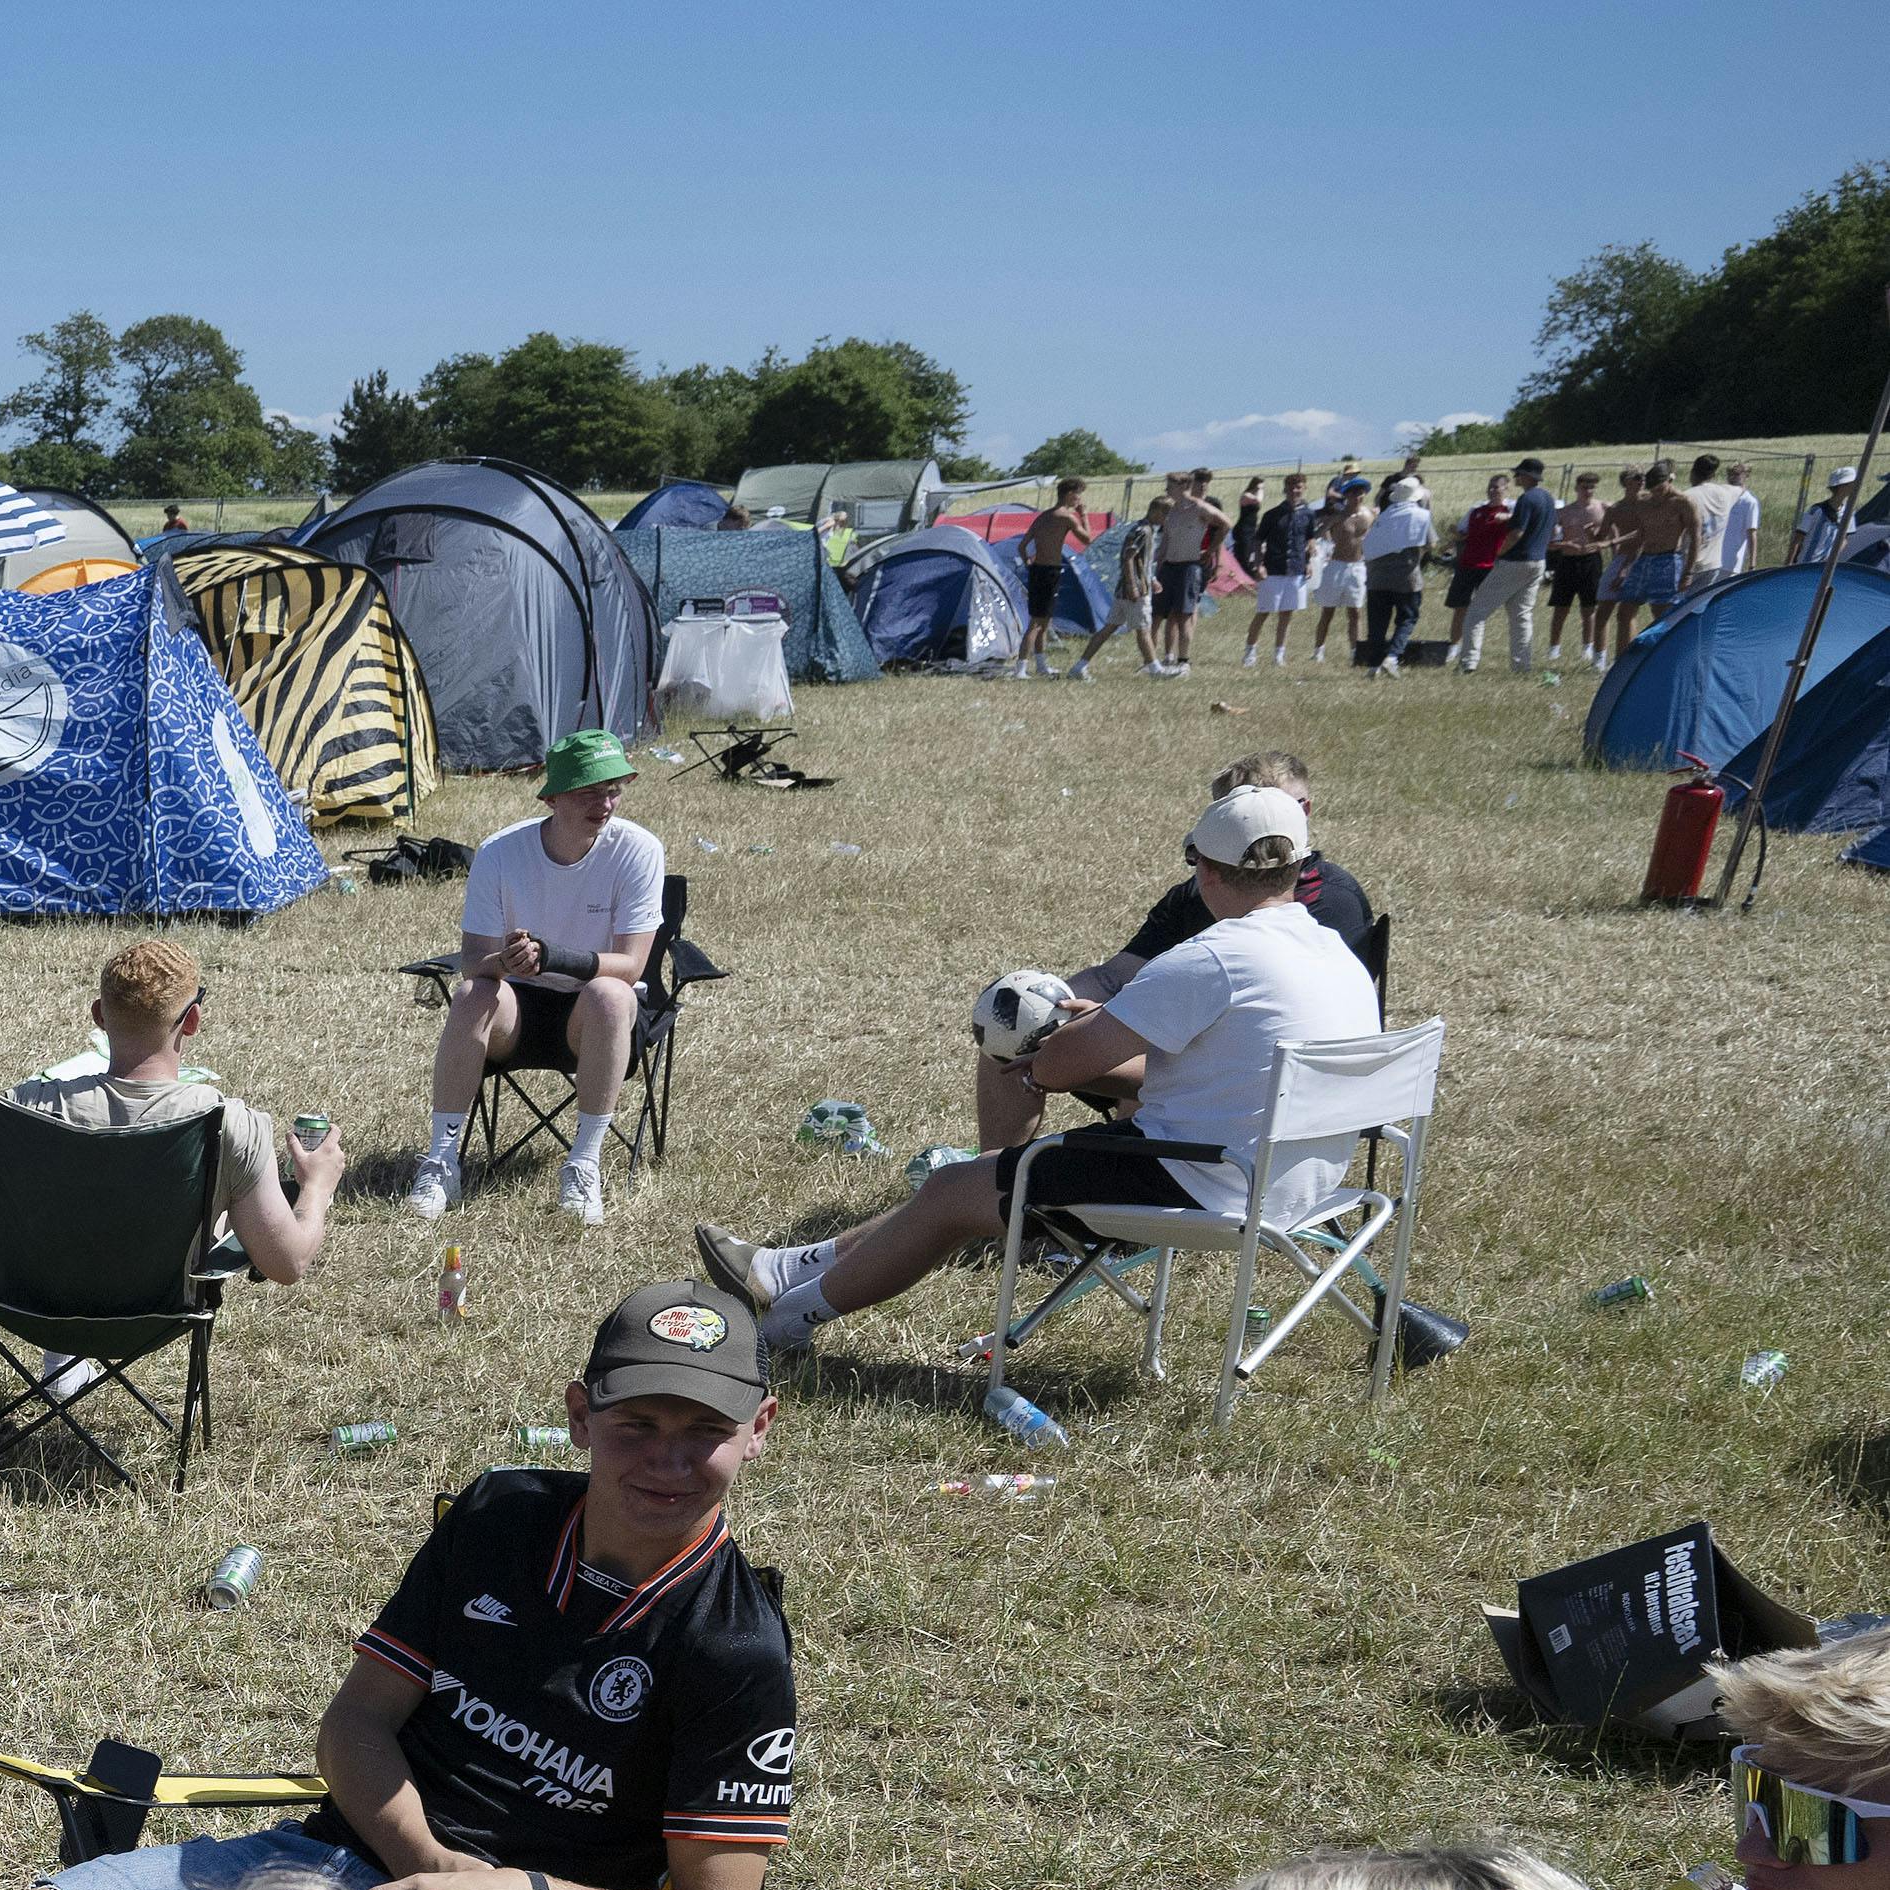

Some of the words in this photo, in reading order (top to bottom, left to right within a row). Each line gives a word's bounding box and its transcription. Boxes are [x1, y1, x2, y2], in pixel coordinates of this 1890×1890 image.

[669, 1311, 689, 1321] PRO
[668, 1327, 691, 1338] SHOP
[1644, 1571, 1661, 1583] til
[609, 1582, 621, 1593] FC
[1644, 1581, 1661, 1592] 2
[1664, 1540, 1702, 1655] Festivalsæt
[473, 1593, 512, 1619] NIKE
[1644, 1589, 1664, 1636] personer
[612, 1660, 647, 1680] CHELSEA
[449, 1688, 614, 1799] YOKOHAMA
